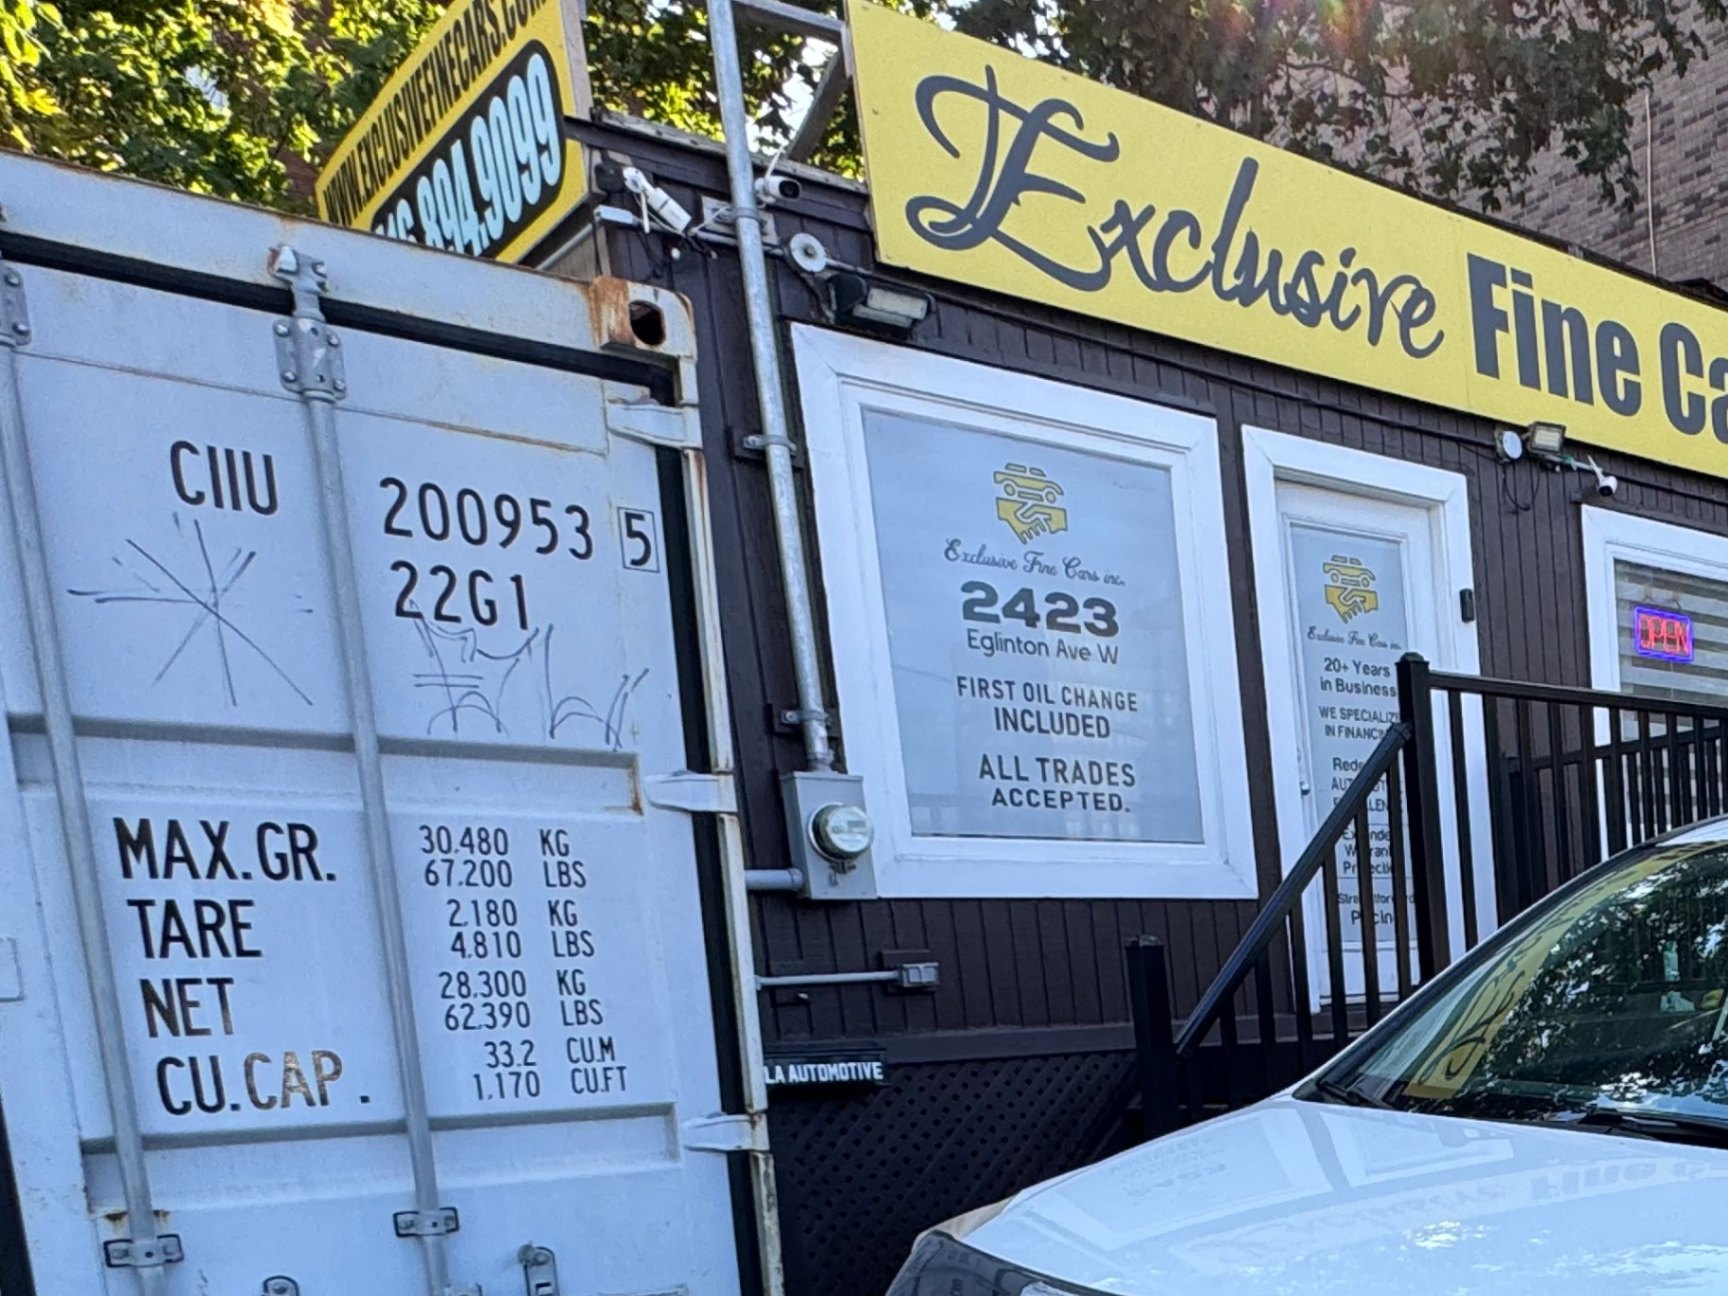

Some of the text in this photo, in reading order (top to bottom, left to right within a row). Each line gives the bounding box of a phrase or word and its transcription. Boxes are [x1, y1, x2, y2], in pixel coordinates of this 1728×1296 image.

[905, 64, 1444, 359] Exclusive
[1466, 252, 1643, 417] Fine
[169, 439, 653, 567] CIIU 200953 5
[390, 559, 529, 631] 22G1
[960, 580, 1120, 638] 2423
[966, 628, 1119, 665] Eglinton Ave W
[1639, 613, 1691, 656] OPEN
[1324, 657, 1391, 678] 20+ Years
[956, 675, 1139, 713] FIRST OIL CHANGE
[1320, 676, 1398, 698] in Business
[993, 706, 1111, 739] INCLUDED
[1318, 705, 1337, 719] WE
[979, 753, 1136, 788] ALL TRADES
[991, 787, 1131, 813] ACCEPTED.
[539, 828, 570, 857] KG
[543, 860, 587, 888] LBS
[126, 899, 263, 959] TARE
[548, 899, 578, 927] KG
[551, 930, 595, 958] LBS
[556, 968, 586, 996] KG
[138, 977, 235, 1038] NET
[560, 998, 603, 1026] LBS
[483, 1036, 616, 1069] 33.2 CU.M
[788, 1061, 884, 1083] AUTOMOTIVE
